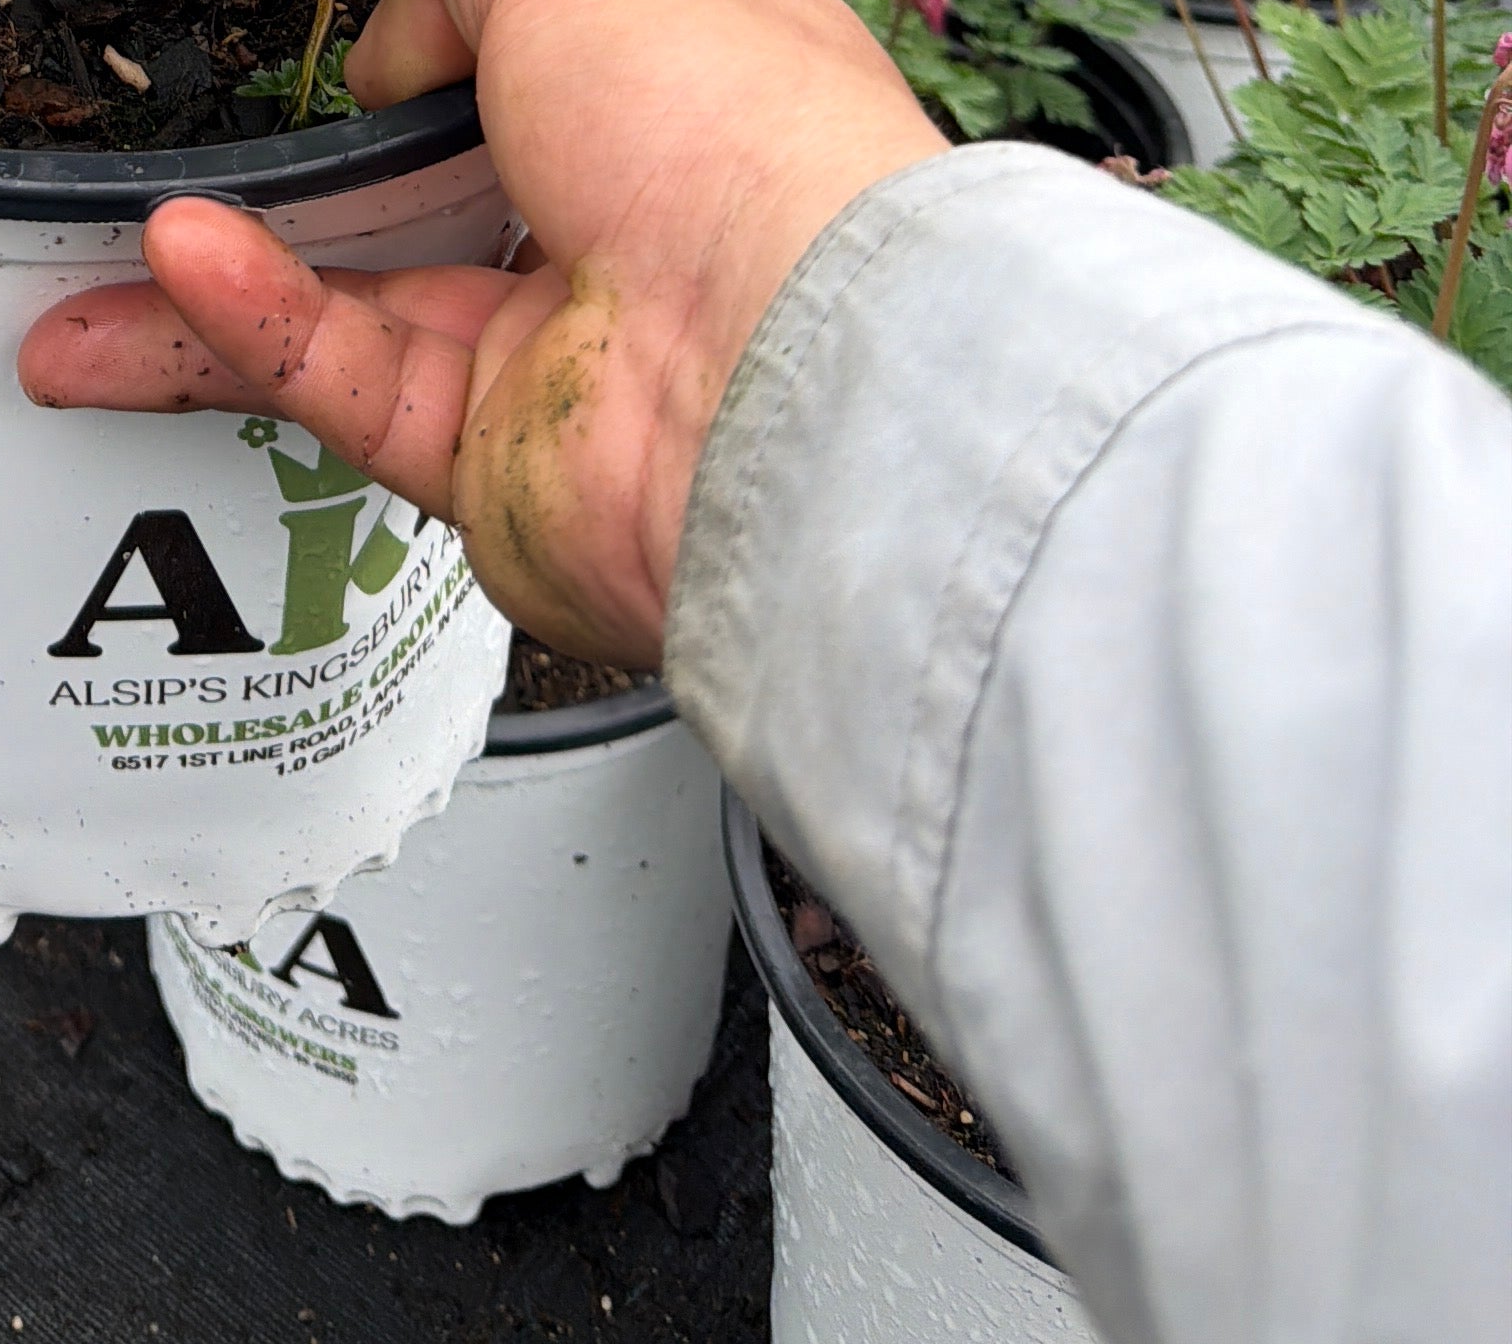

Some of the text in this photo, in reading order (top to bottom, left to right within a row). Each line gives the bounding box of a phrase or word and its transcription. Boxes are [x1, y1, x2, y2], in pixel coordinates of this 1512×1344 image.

[49, 541, 435, 707] ALSIP'S KINGSBURY
[90, 679, 363, 748] WHOLESALE
[275, 757, 307, 776] 1.0
[311, 736, 346, 763] Gal
[348, 729, 357, 747] /
[358, 701, 394, 738] 3.79
[111, 753, 169, 770] 6517
[177, 748, 224, 768] 1ST
[228, 742, 283, 765] LINE
[298, 1007, 400, 1052] ACRES
